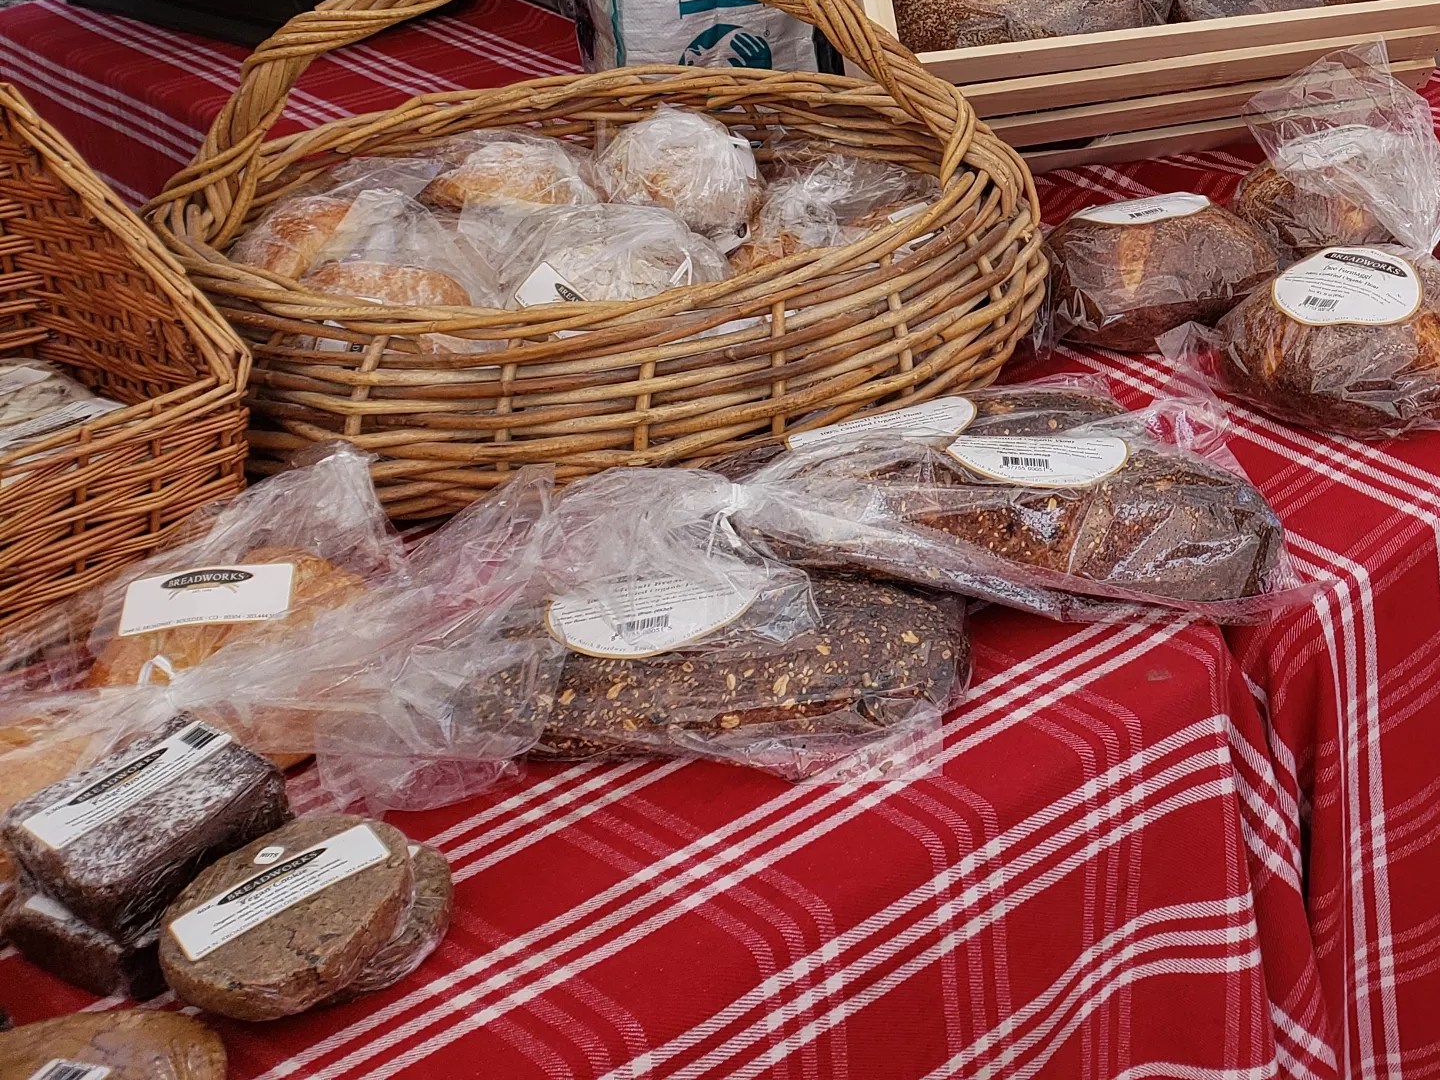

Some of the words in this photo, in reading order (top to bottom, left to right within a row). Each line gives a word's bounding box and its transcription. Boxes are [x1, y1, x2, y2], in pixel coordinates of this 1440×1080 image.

[1330, 253, 1400, 275] BREADWORKS
[168, 572, 245, 588] BREADWORKS
[77, 751, 161, 804] BREADWORKS
[227, 851, 320, 902] BREADWORKS
